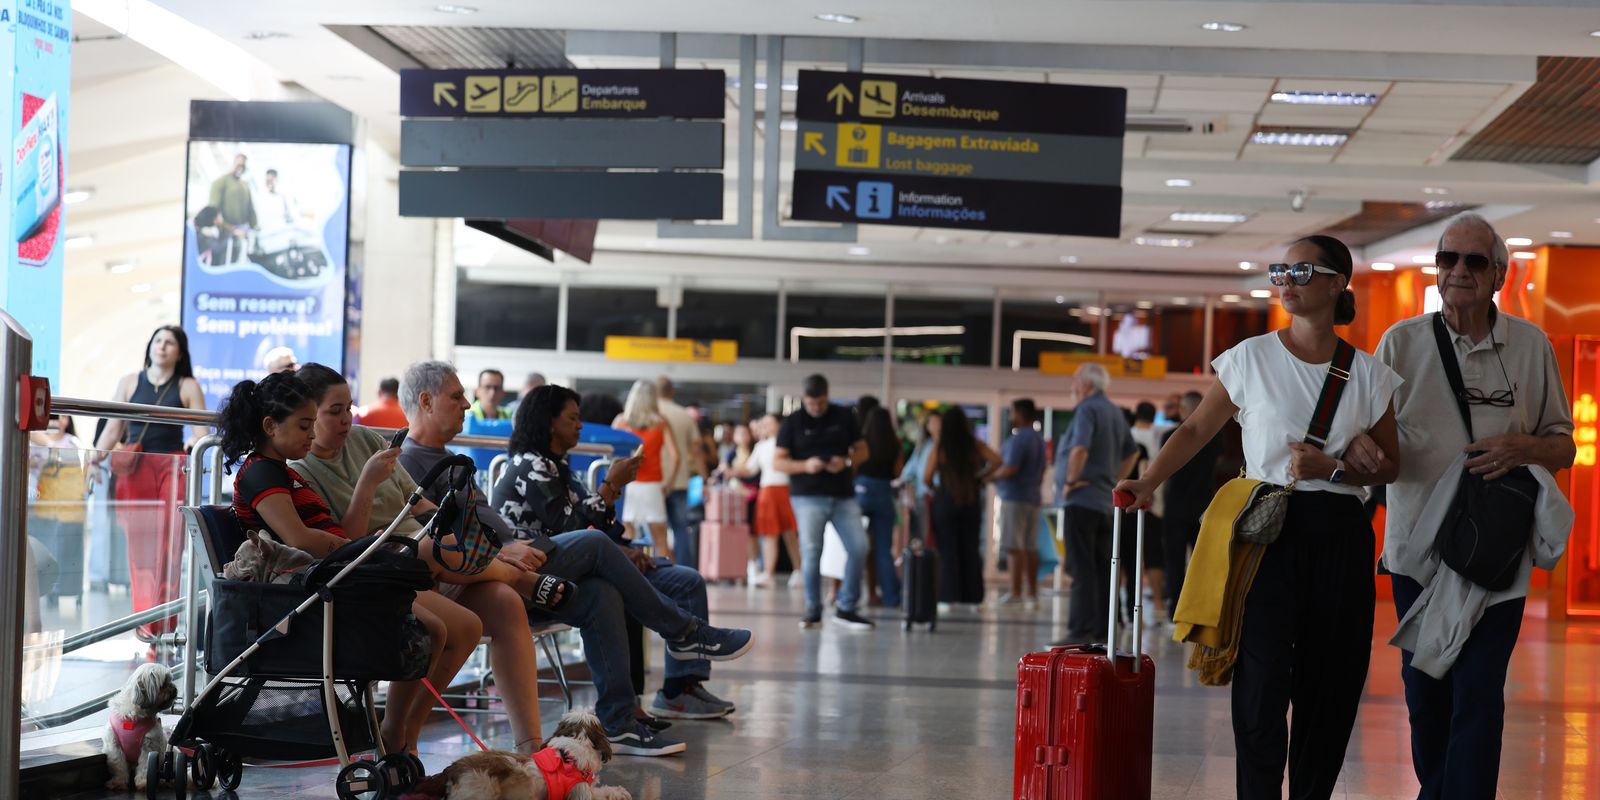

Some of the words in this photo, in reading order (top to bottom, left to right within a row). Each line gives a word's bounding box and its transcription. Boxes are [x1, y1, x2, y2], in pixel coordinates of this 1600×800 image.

[581, 83, 640, 96] Departures
[901, 90, 946, 104] Arrivals
[581, 97, 647, 112] Embarque
[901, 102, 1000, 122] Desembarque
[887, 130, 957, 150] Bagagem
[960, 134, 1040, 153] Extraviada
[885, 157, 913, 170] Lost
[915, 158, 974, 176] baggage
[898, 191, 963, 206] Information
[898, 204, 987, 222] Informações
[196, 292, 237, 313] Sem
[238, 295, 317, 315] reserva?
[195, 314, 236, 335] Sem
[535, 575, 557, 605] VANS
